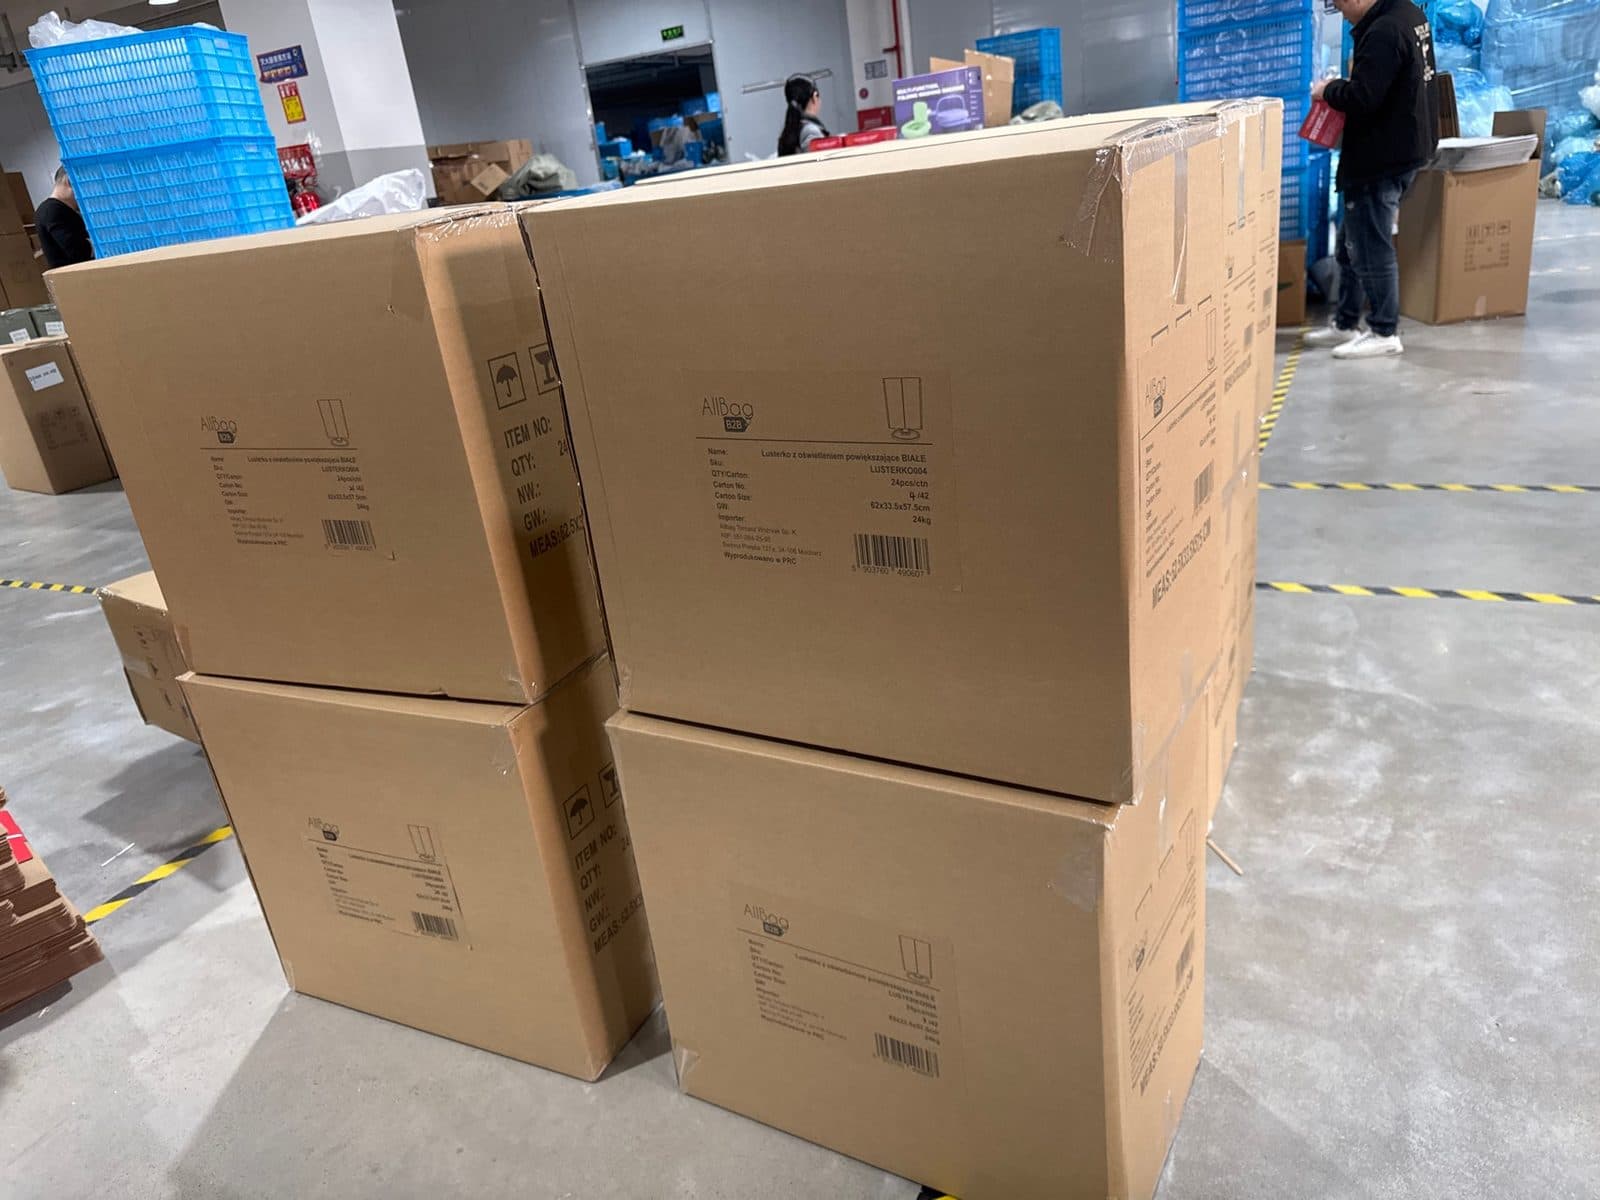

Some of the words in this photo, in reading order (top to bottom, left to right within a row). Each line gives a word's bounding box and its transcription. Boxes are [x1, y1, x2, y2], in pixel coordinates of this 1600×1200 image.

[701, 397, 755, 420] AllBag
[504, 424, 531, 449] ITEM
[533, 416, 553, 436] NO:
[511, 453, 537, 478] QTY:
[870, 465, 928, 474] LUSTERKO004
[890, 478, 929, 488] 24pcs/ctn
[912, 515, 932, 525] 24kg
[574, 840, 597, 870] ITEM
[599, 824, 617, 847] NO:
[580, 864, 601, 890] QTY:
